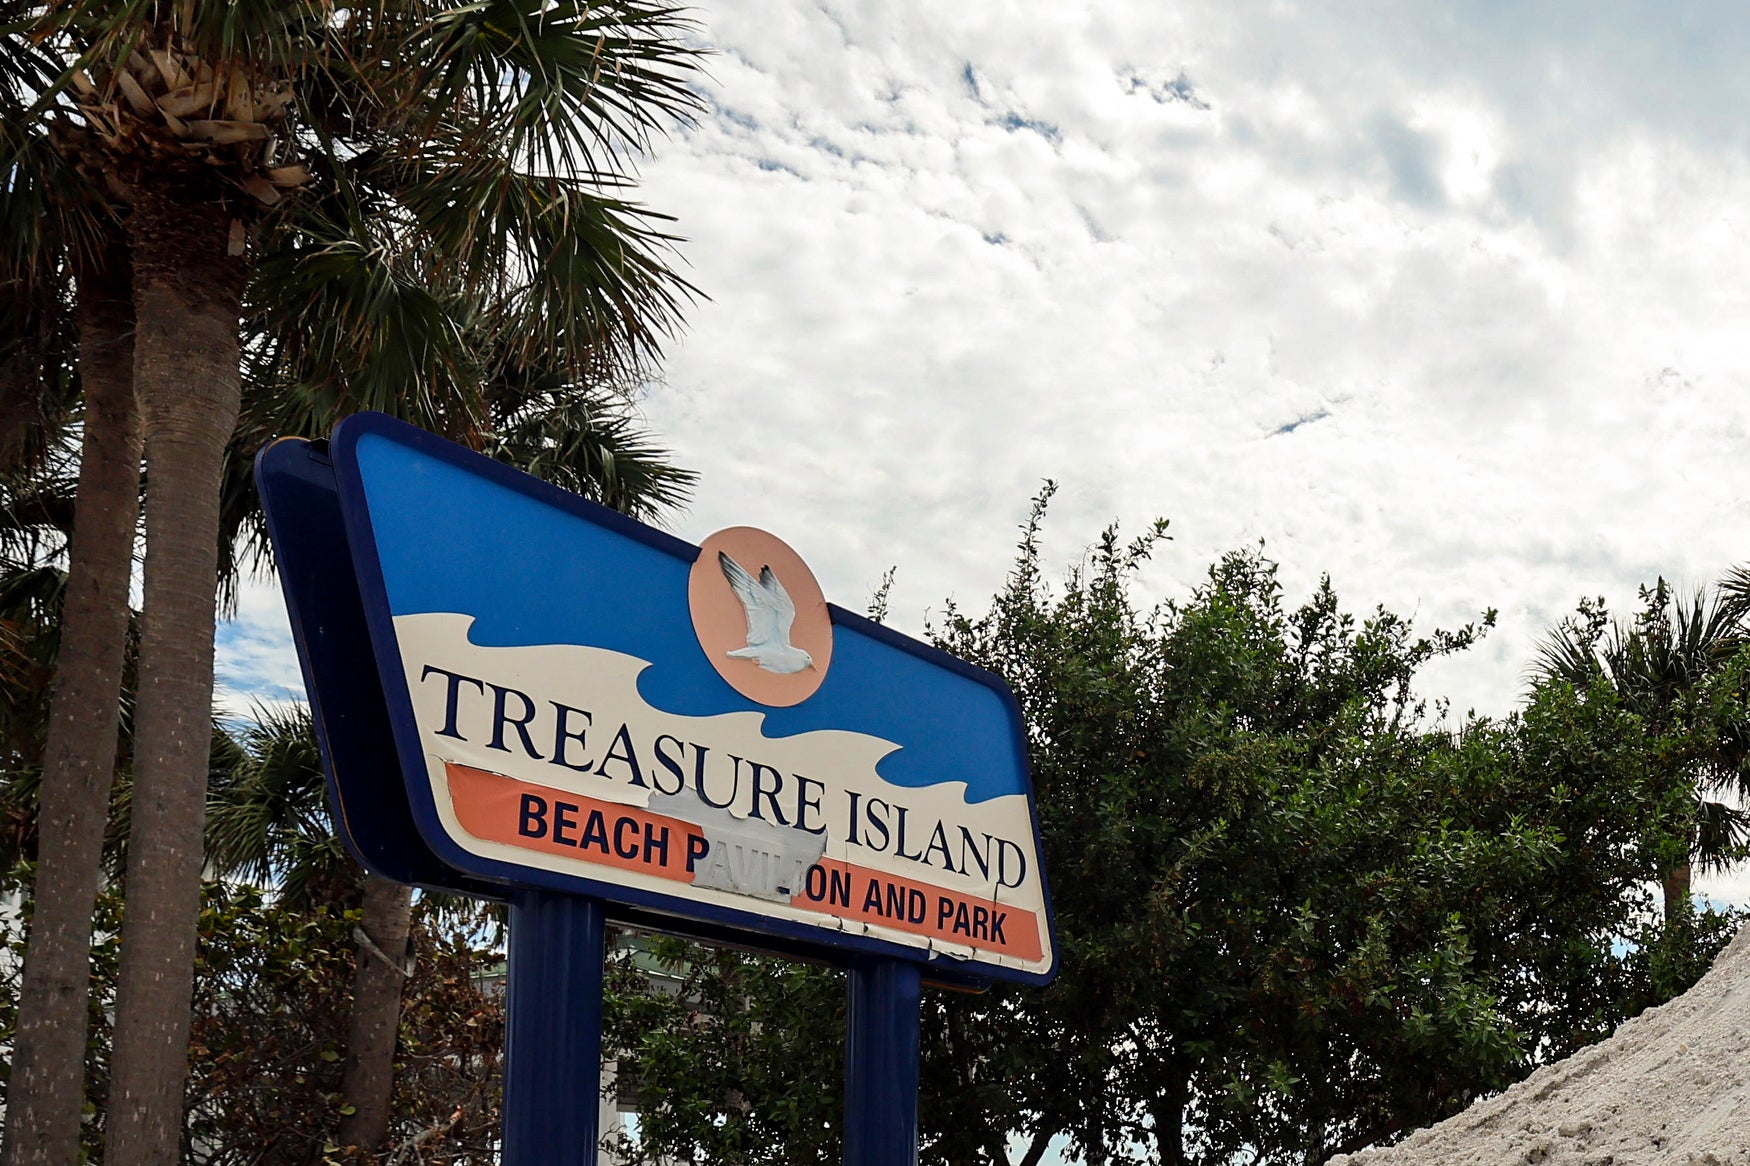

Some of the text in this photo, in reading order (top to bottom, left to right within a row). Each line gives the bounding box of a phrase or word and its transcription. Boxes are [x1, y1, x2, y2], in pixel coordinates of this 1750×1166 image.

[420, 664, 1027, 889] TREASURE ISLAND
[518, 793, 670, 868] BEACH
[862, 878, 927, 925] AND
[937, 896, 1007, 946] PARK
